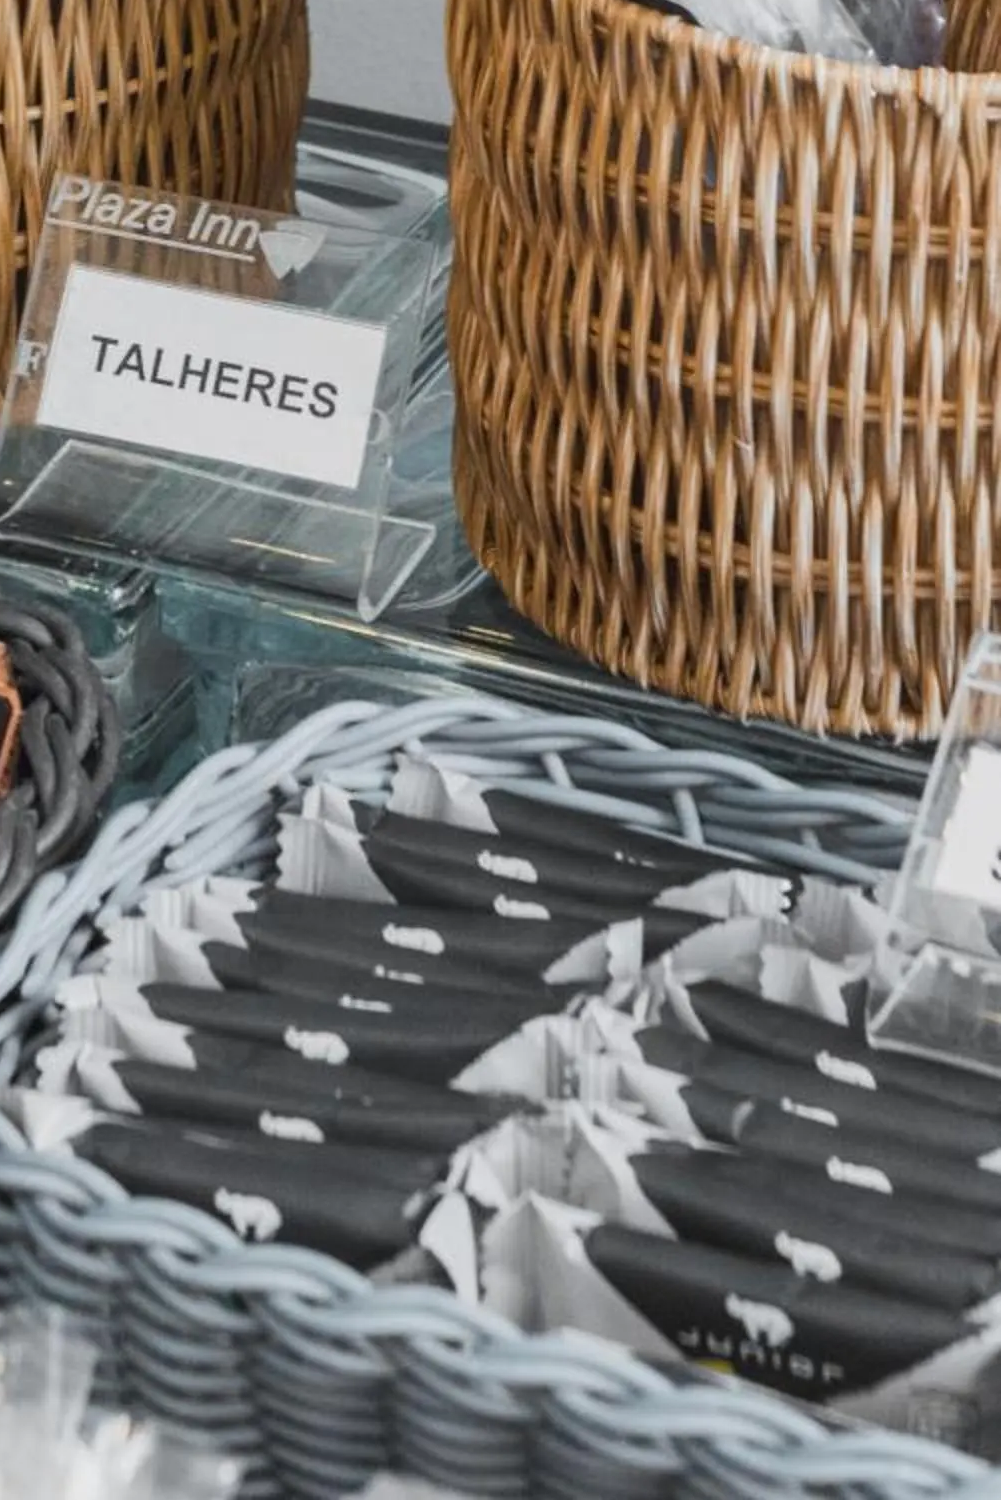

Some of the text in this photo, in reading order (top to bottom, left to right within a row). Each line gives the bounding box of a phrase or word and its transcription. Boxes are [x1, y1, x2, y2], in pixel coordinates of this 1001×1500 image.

[51, 175, 260, 250] Plaza Inn
[92, 335, 338, 419] TALHERES
